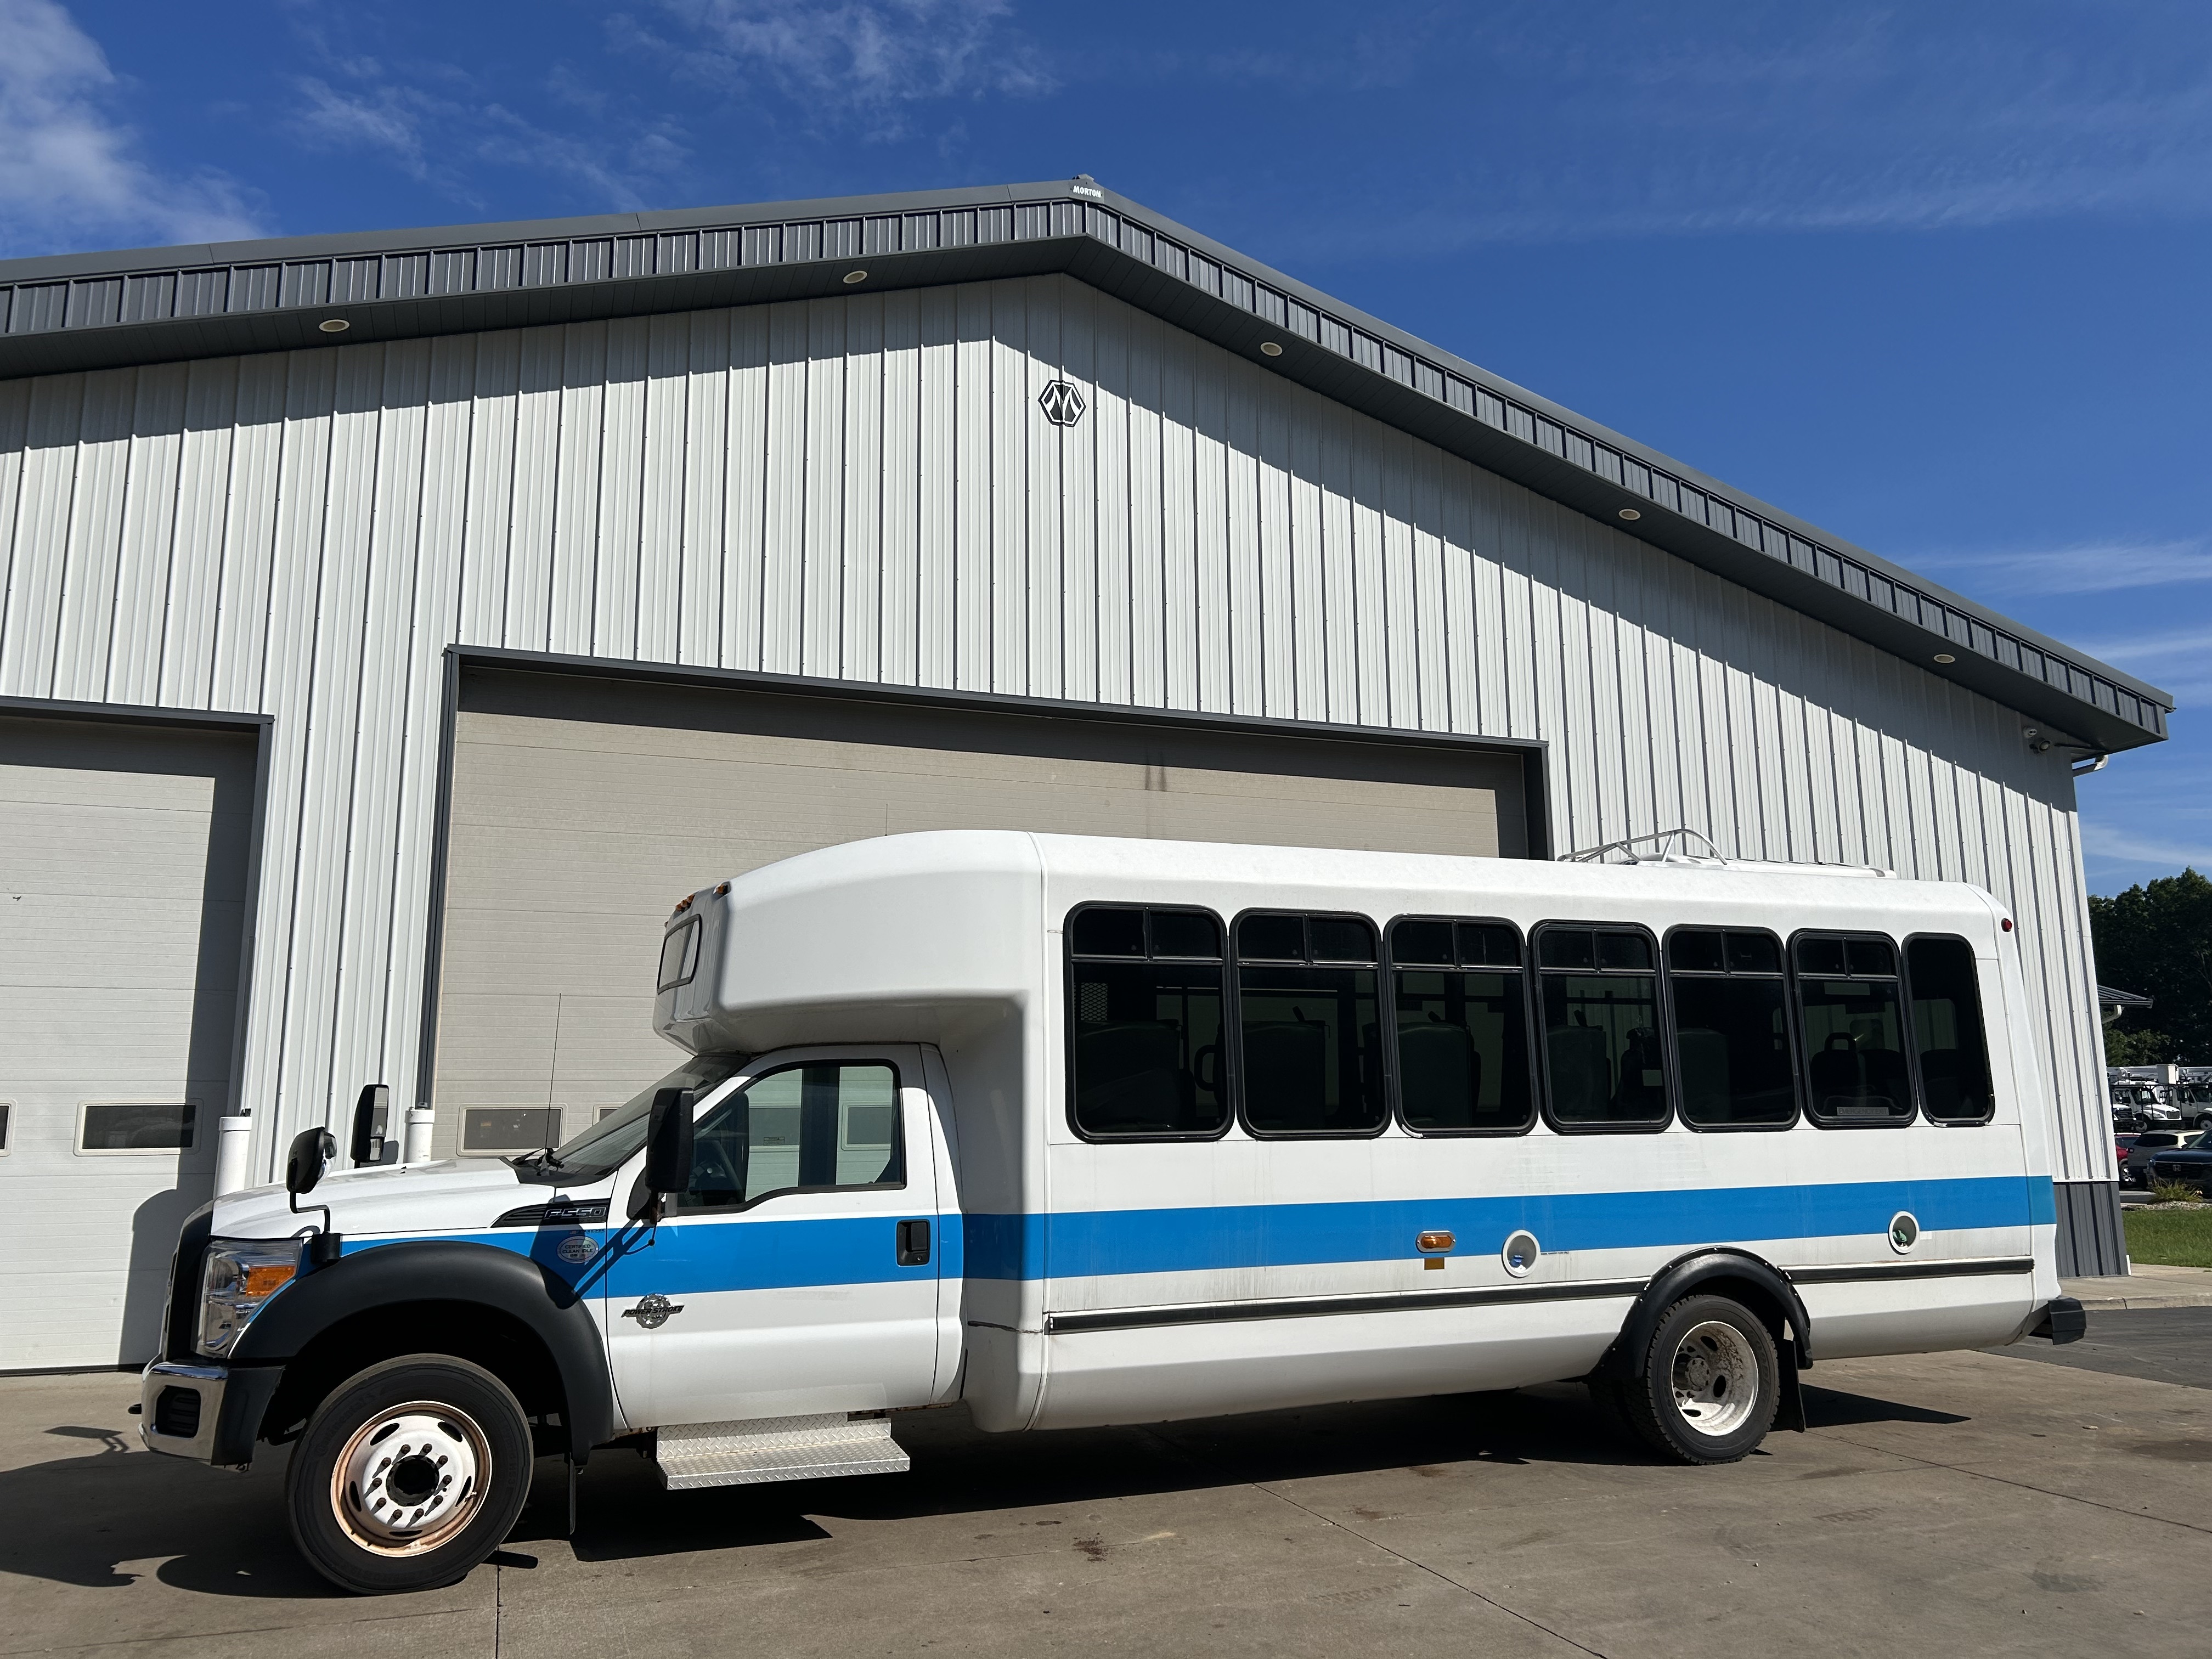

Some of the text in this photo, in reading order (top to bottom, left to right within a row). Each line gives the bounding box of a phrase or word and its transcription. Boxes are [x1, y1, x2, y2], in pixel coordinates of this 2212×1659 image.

[1073, 185, 1101, 198] MORTON
[545, 1207, 606, 1219] F-550
[652, 1305, 684, 1313] STROKE
